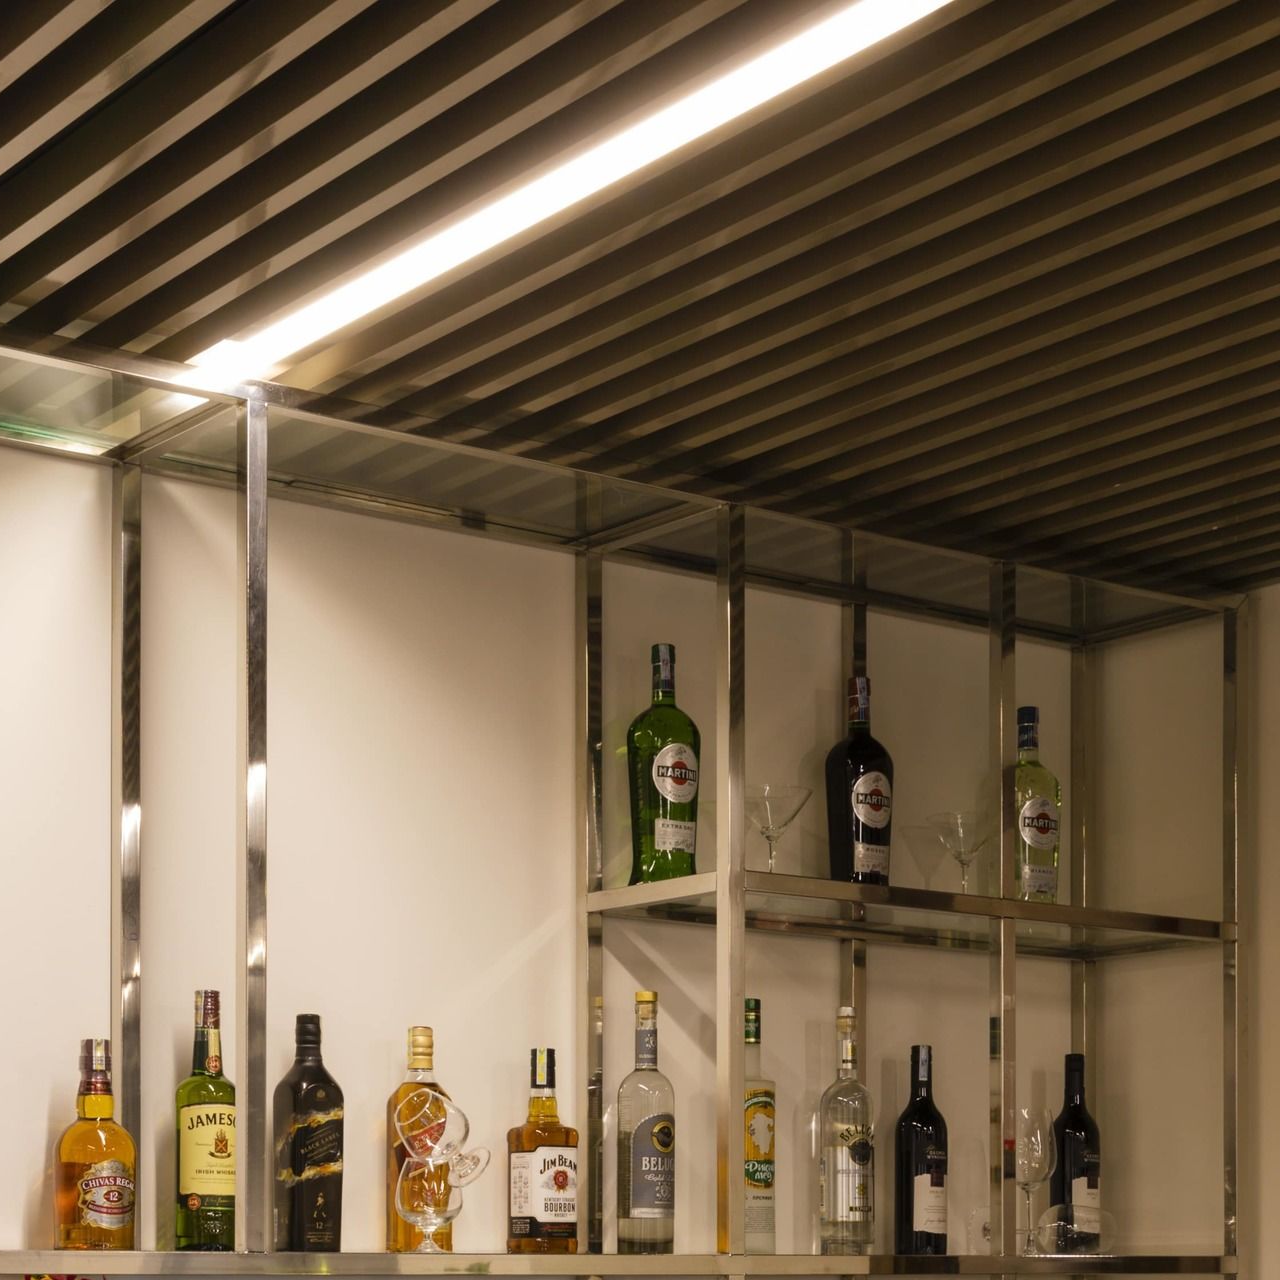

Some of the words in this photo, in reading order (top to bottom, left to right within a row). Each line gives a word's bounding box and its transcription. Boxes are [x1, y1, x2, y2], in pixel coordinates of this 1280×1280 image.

[660, 767, 696, 781] MARTINI
[300, 1140, 320, 1155] BLACK
[321, 1132, 340, 1145] LABEL
[540, 1157, 557, 1174] JIM
[82, 1177, 115, 1190] CHIVAS
[110, 1191, 118, 1201] 12
[544, 1202, 576, 1212] BOURBON
[315, 1222, 324, 1230] 12
